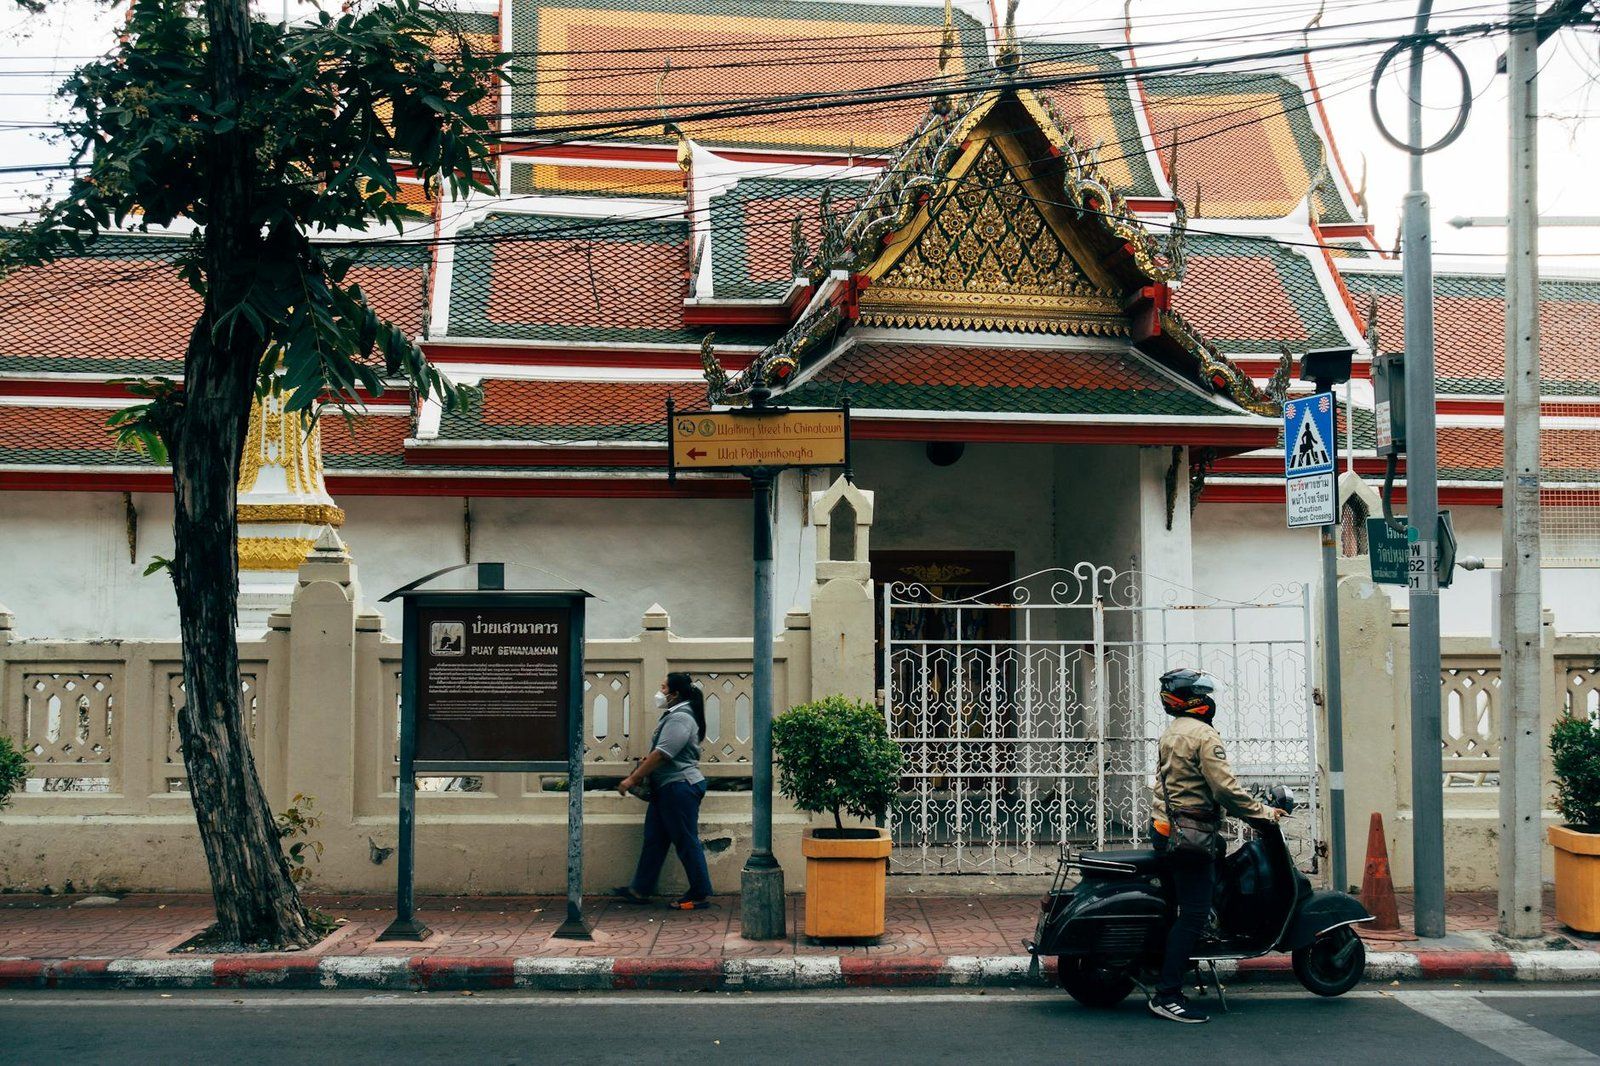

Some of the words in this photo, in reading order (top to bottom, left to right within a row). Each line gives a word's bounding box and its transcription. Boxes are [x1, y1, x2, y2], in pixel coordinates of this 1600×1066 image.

[717, 423, 755, 437] Walking
[757, 423, 781, 435] Street
[793, 422, 842, 435] Chinatown
[717, 447, 738, 460] Wat
[1298, 505, 1323, 514] Caution
[1289, 515, 1309, 523] Student
[1309, 513, 1332, 521] Crossing
[1408, 559, 1425, 572] 62
[471, 614, 558, 634] ป่วยเสวนาคาร
[471, 646, 494, 656] PUAY
[497, 646, 559, 656] SEWANAKHAN
